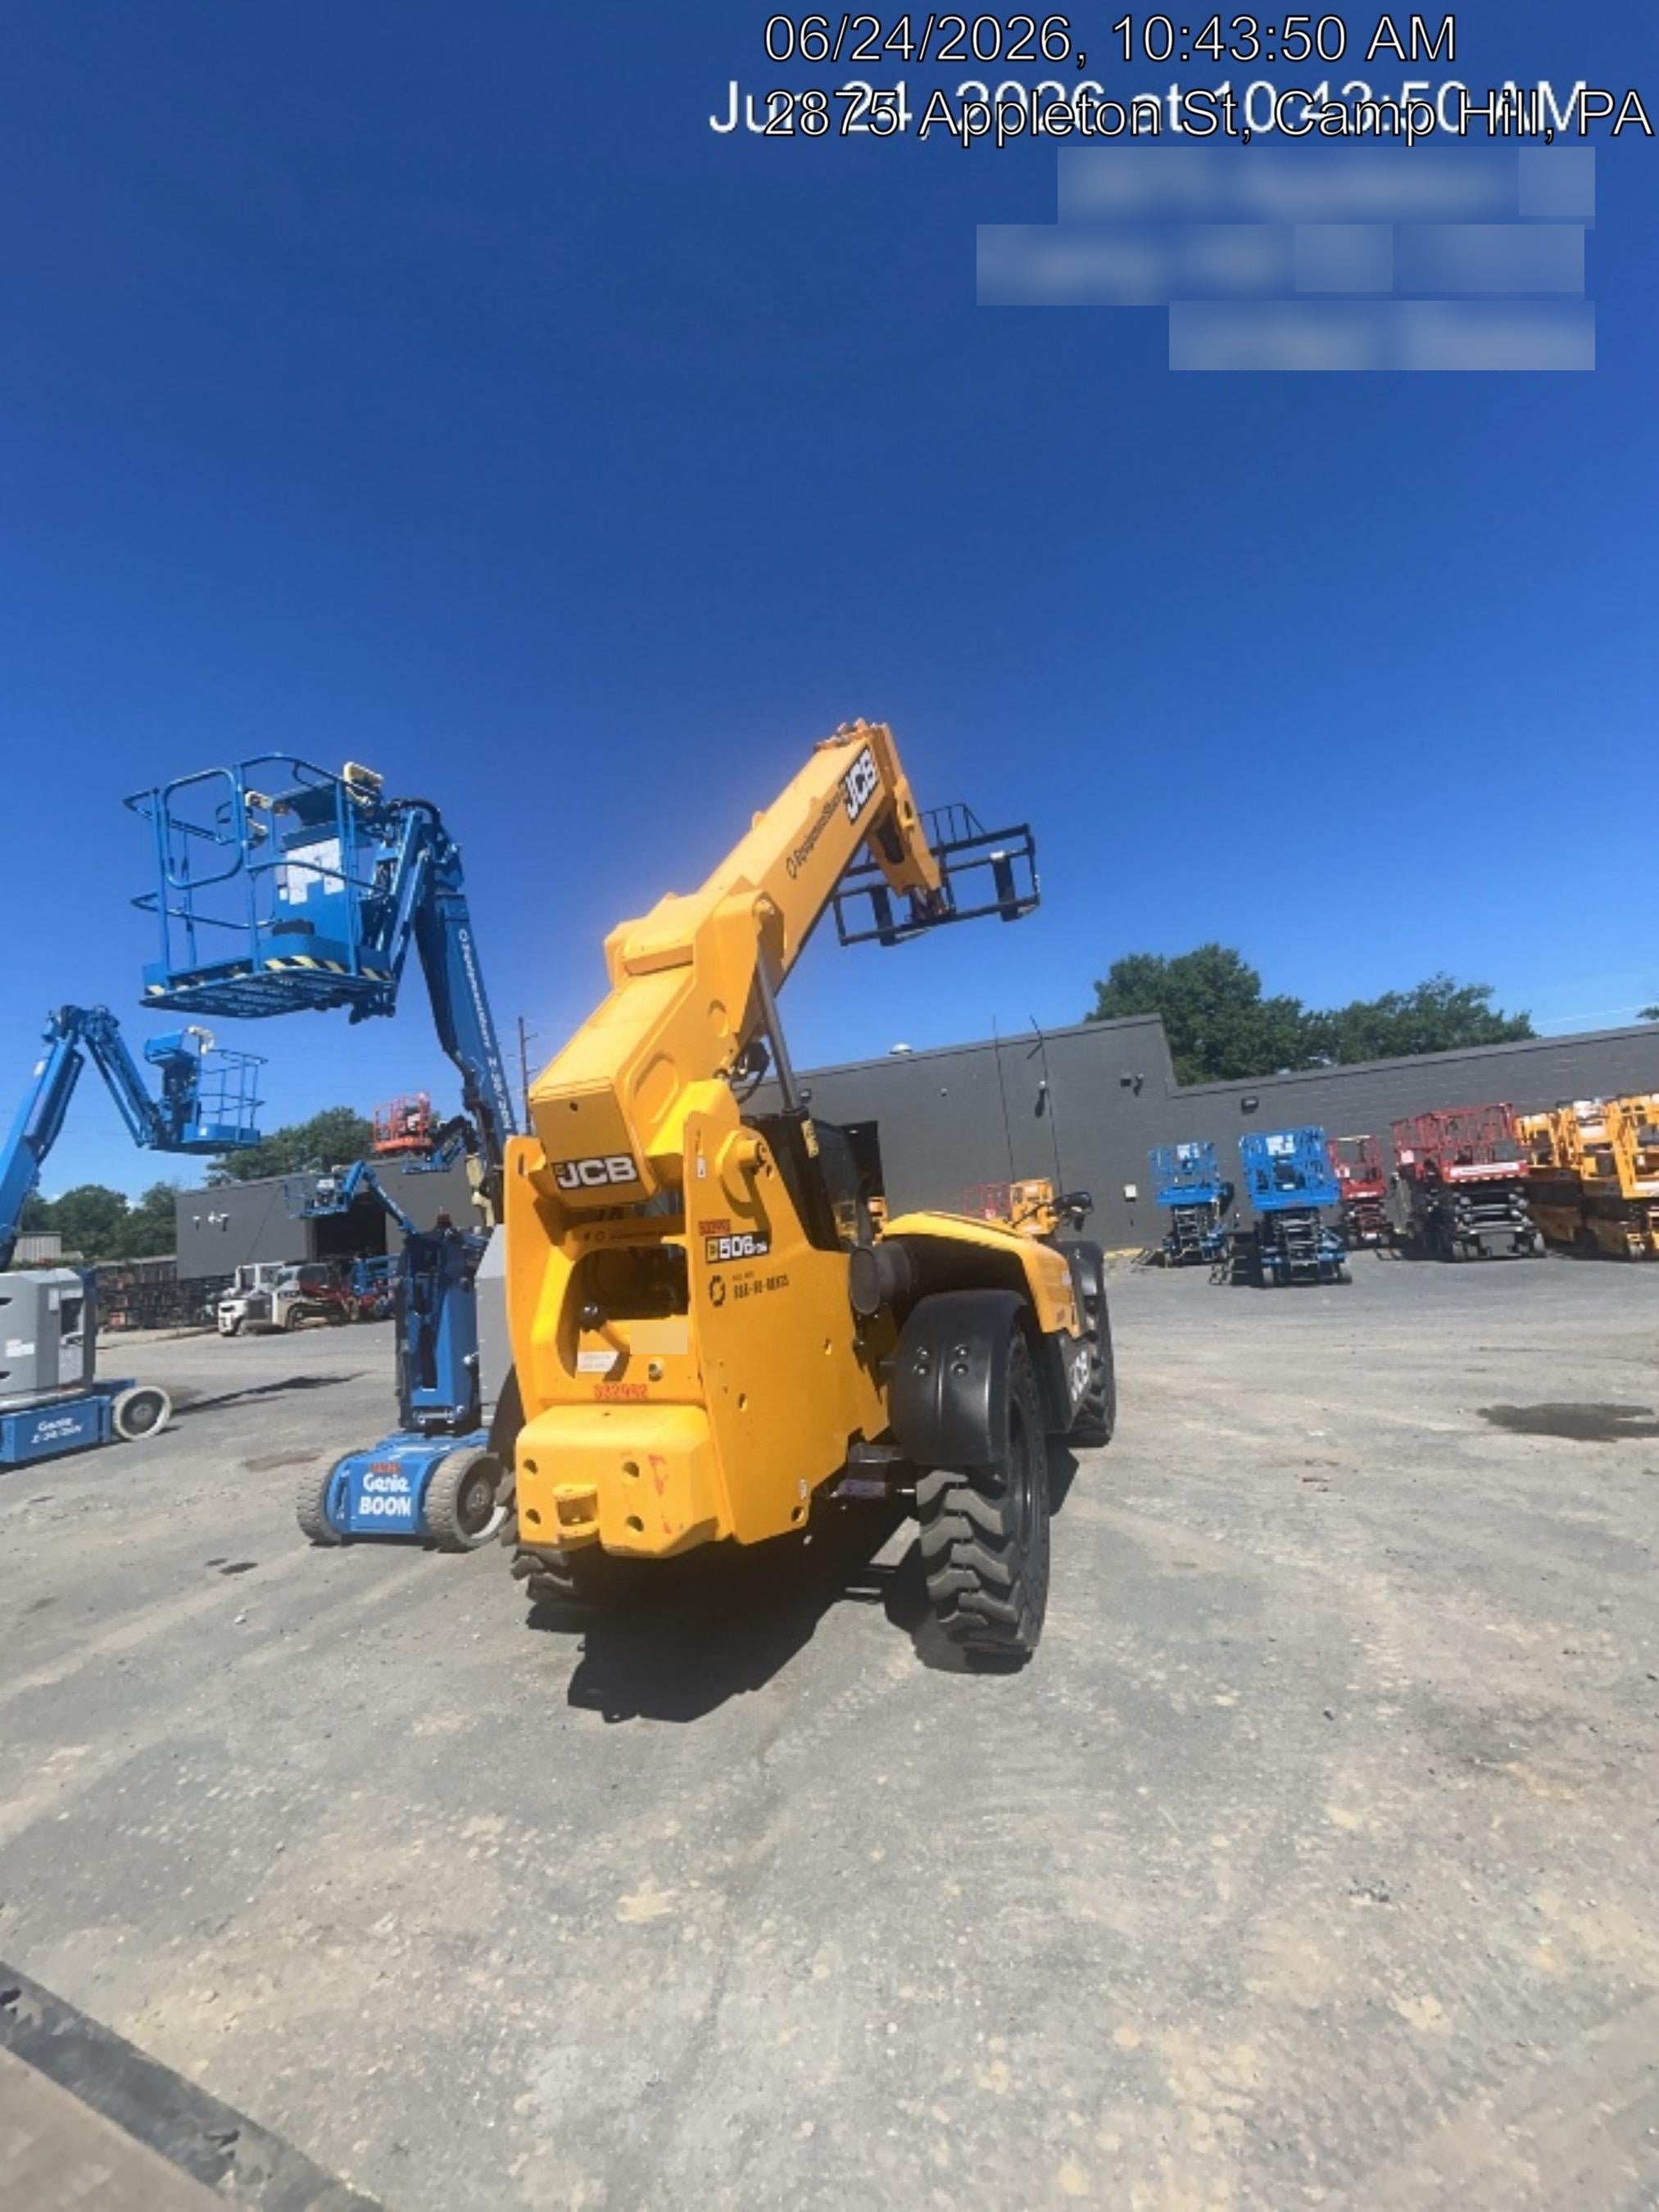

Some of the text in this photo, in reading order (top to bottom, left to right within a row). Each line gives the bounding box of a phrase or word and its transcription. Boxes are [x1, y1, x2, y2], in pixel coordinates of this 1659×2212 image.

[845, 746, 880, 821] JCB
[557, 1156, 637, 1188] JCB
[362, 1471, 411, 1493] Genie
[359, 1496, 411, 1517] BOOM
